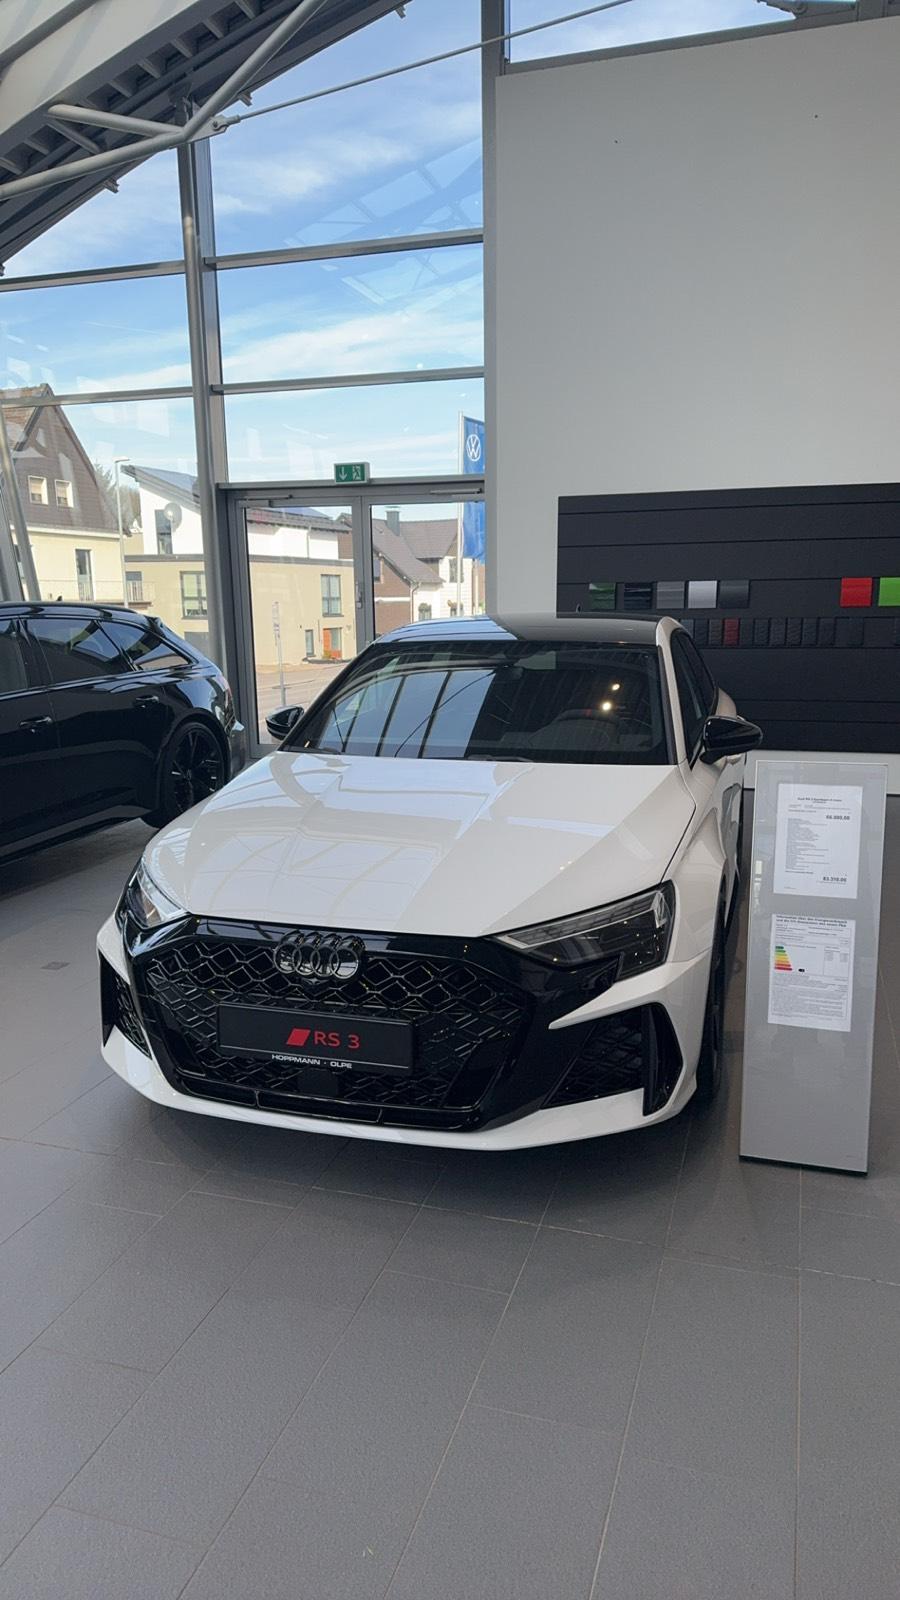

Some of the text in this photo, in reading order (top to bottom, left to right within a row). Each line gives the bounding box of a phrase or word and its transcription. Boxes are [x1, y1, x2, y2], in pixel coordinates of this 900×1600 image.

[466, 434, 481, 461] VW
[314, 1031, 360, 1049] RS 3
[271, 1054, 352, 1069] HOPPMANN OLPE
